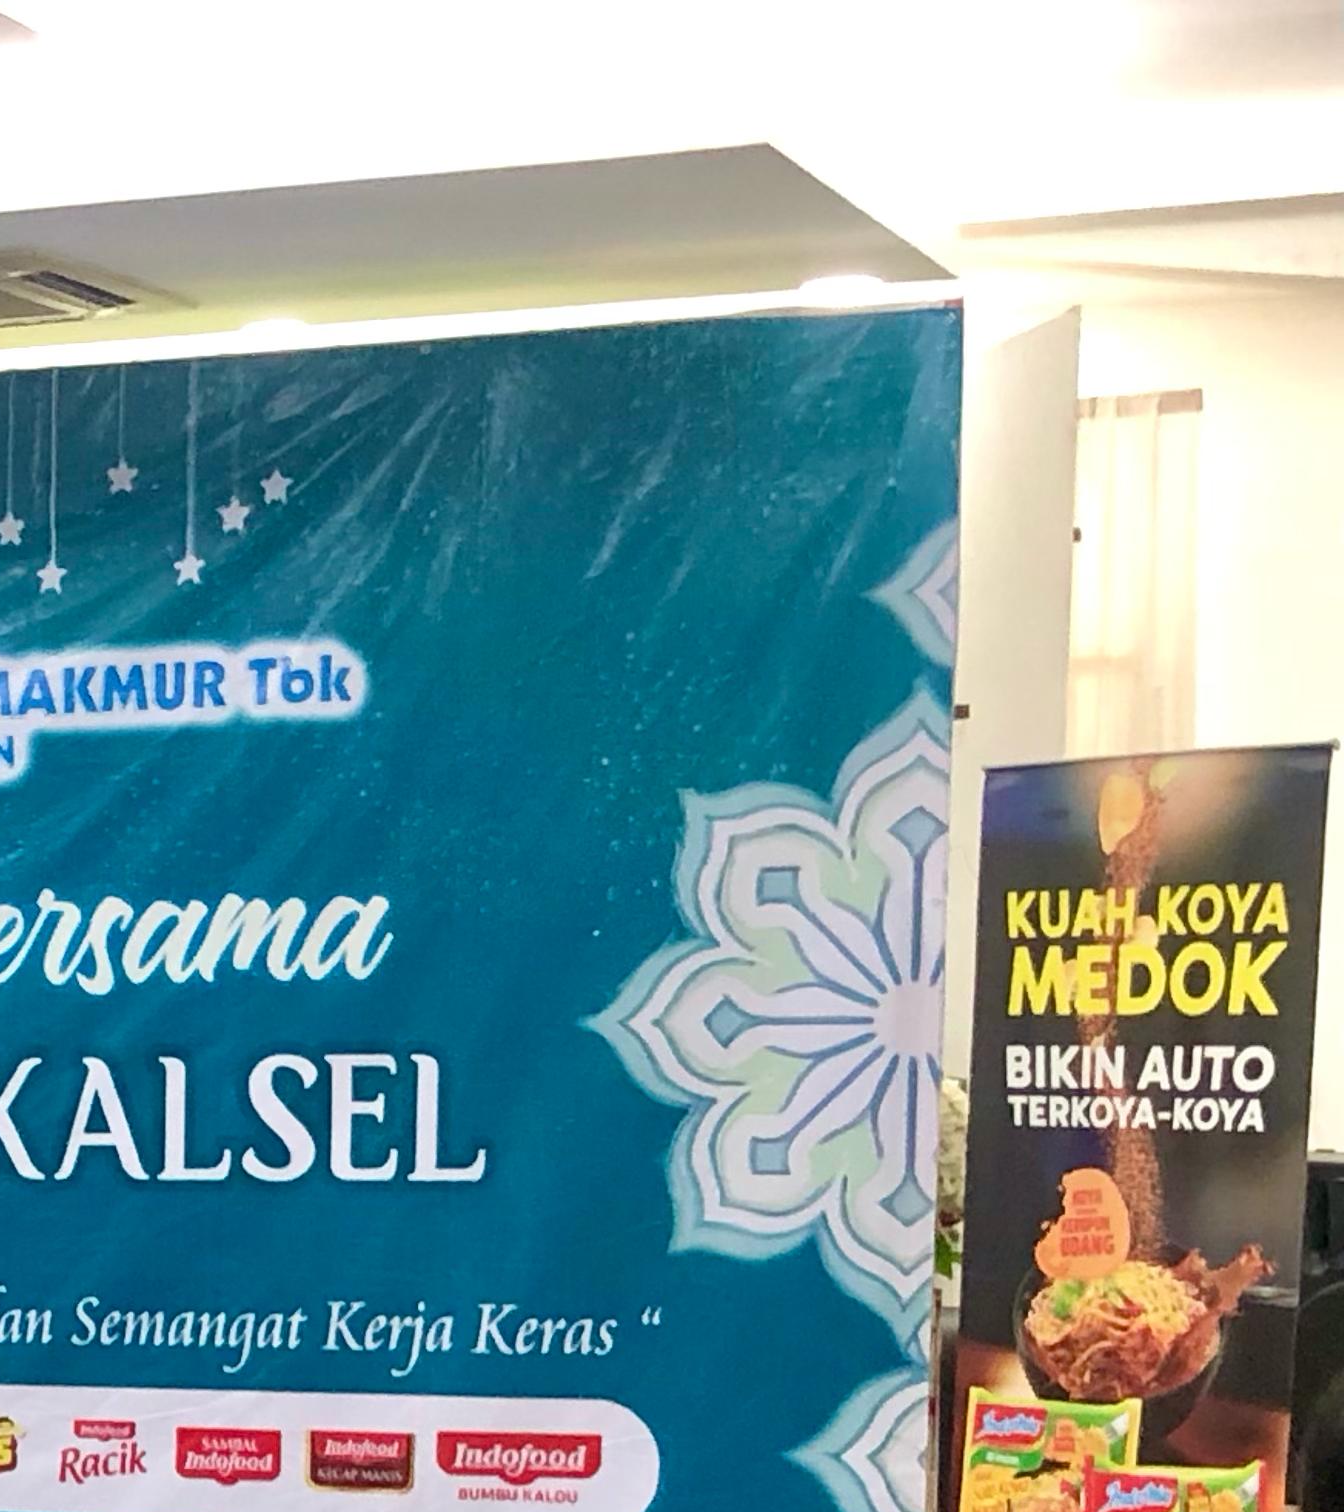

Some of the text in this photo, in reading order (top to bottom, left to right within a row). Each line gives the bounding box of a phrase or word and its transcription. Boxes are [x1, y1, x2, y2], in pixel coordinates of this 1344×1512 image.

[1005, 882, 1290, 939] KUAH KOYA
[1007, 940, 1288, 1018] MEDOK
[1005, 1045, 1276, 1093] BIKIN AUTO
[1007, 1094, 1265, 1133] TERKOYA-KOYA
[70, 1296, 309, 1373] Semangat
[322, 1301, 454, 1377] Kerja
[470, 1303, 618, 1356] Keras
[58, 1442, 147, 1484] Racik
[183, 1451, 274, 1477] Indofood
[454, 1442, 587, 1476] Indofood
